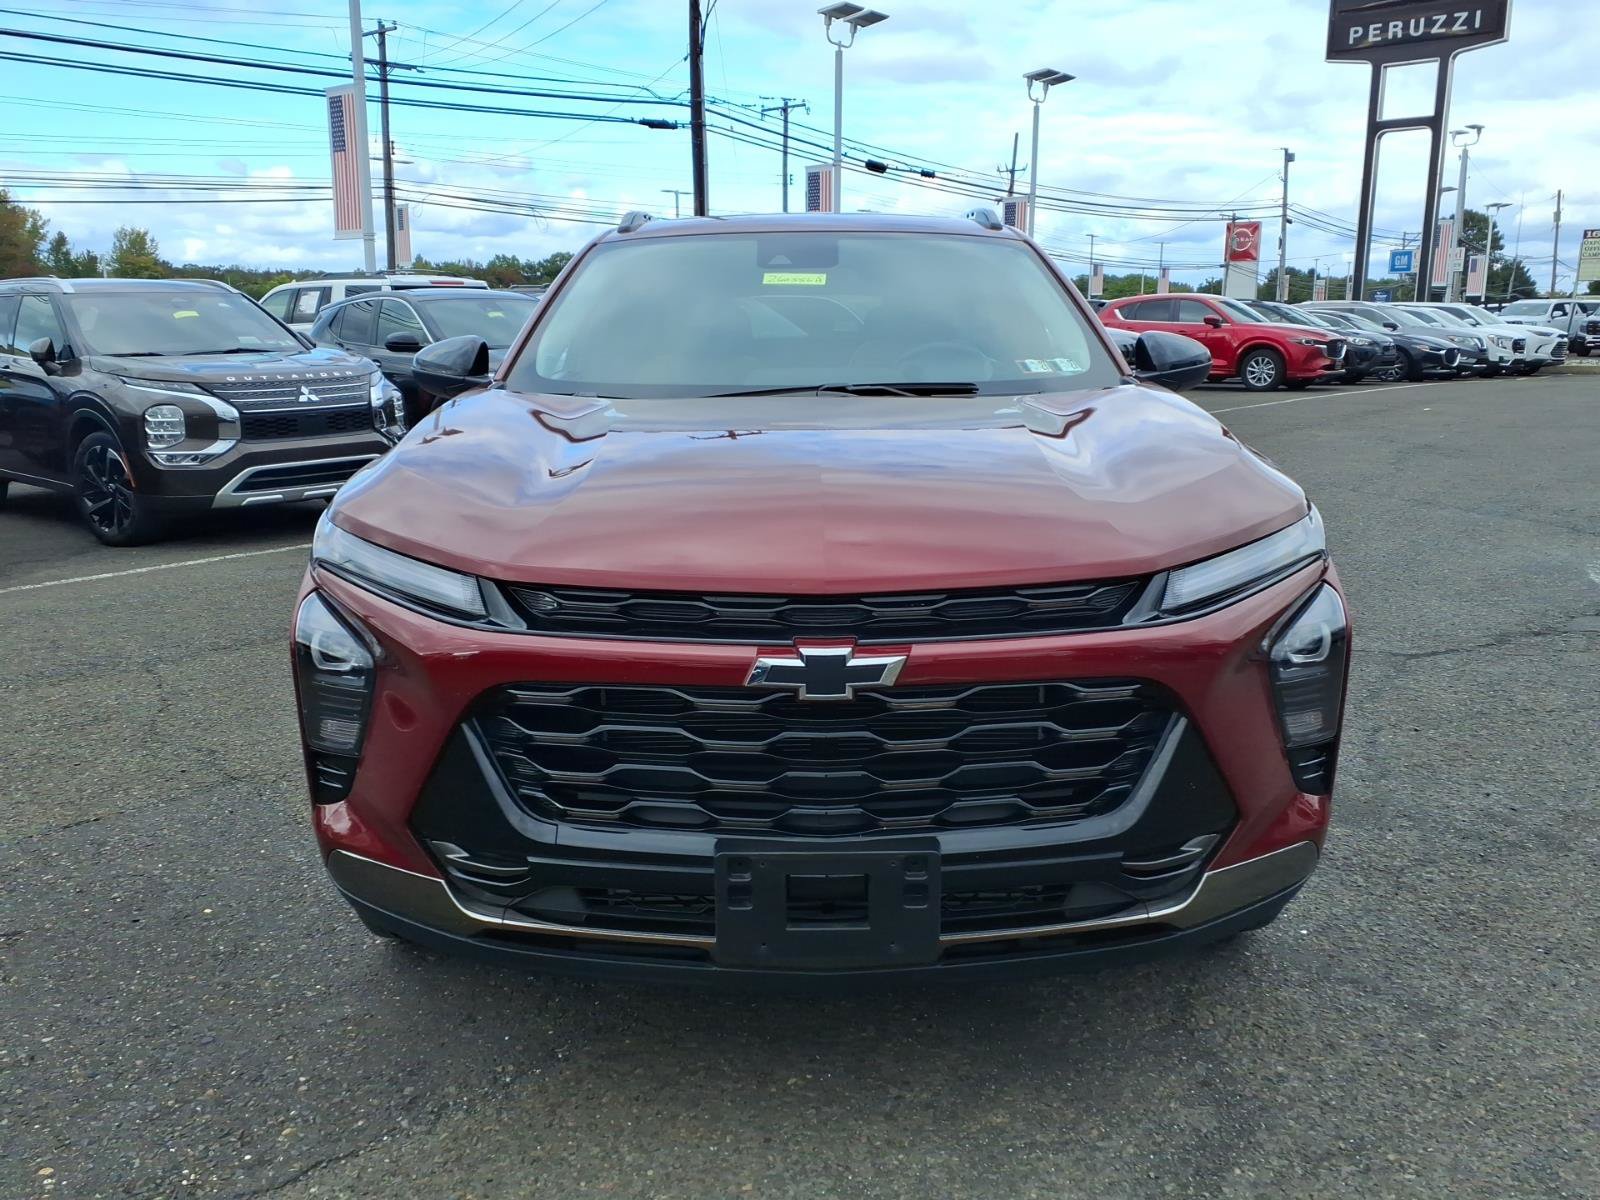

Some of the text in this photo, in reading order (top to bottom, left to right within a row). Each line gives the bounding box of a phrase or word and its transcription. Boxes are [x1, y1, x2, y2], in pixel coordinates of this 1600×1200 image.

[1348, 9, 1482, 45] PERUZZI
[1395, 255, 1408, 266] GM
[226, 370, 354, 381] OUTLANDER
